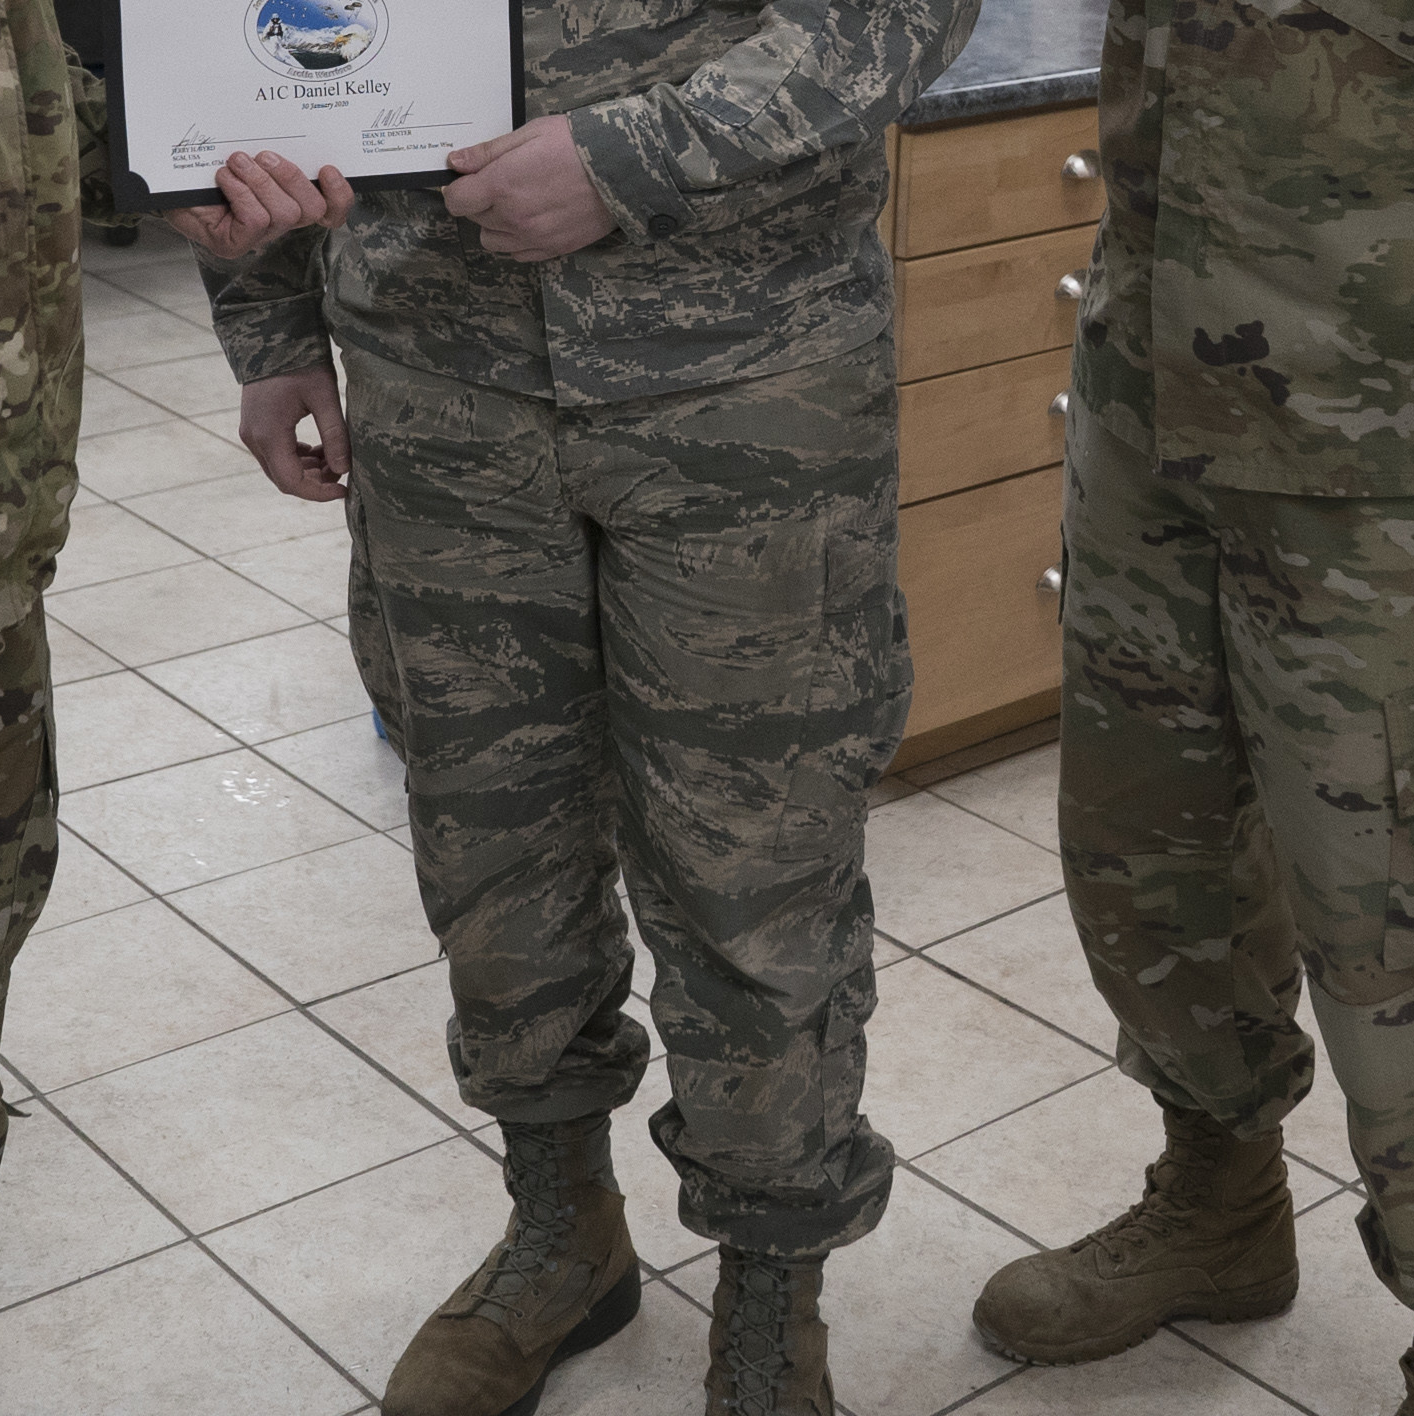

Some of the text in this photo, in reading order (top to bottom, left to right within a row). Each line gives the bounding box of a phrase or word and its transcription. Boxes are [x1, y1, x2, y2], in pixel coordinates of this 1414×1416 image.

[255, 80, 391, 101] A1C Daniel Kelley
[310, 102, 334, 110] January
